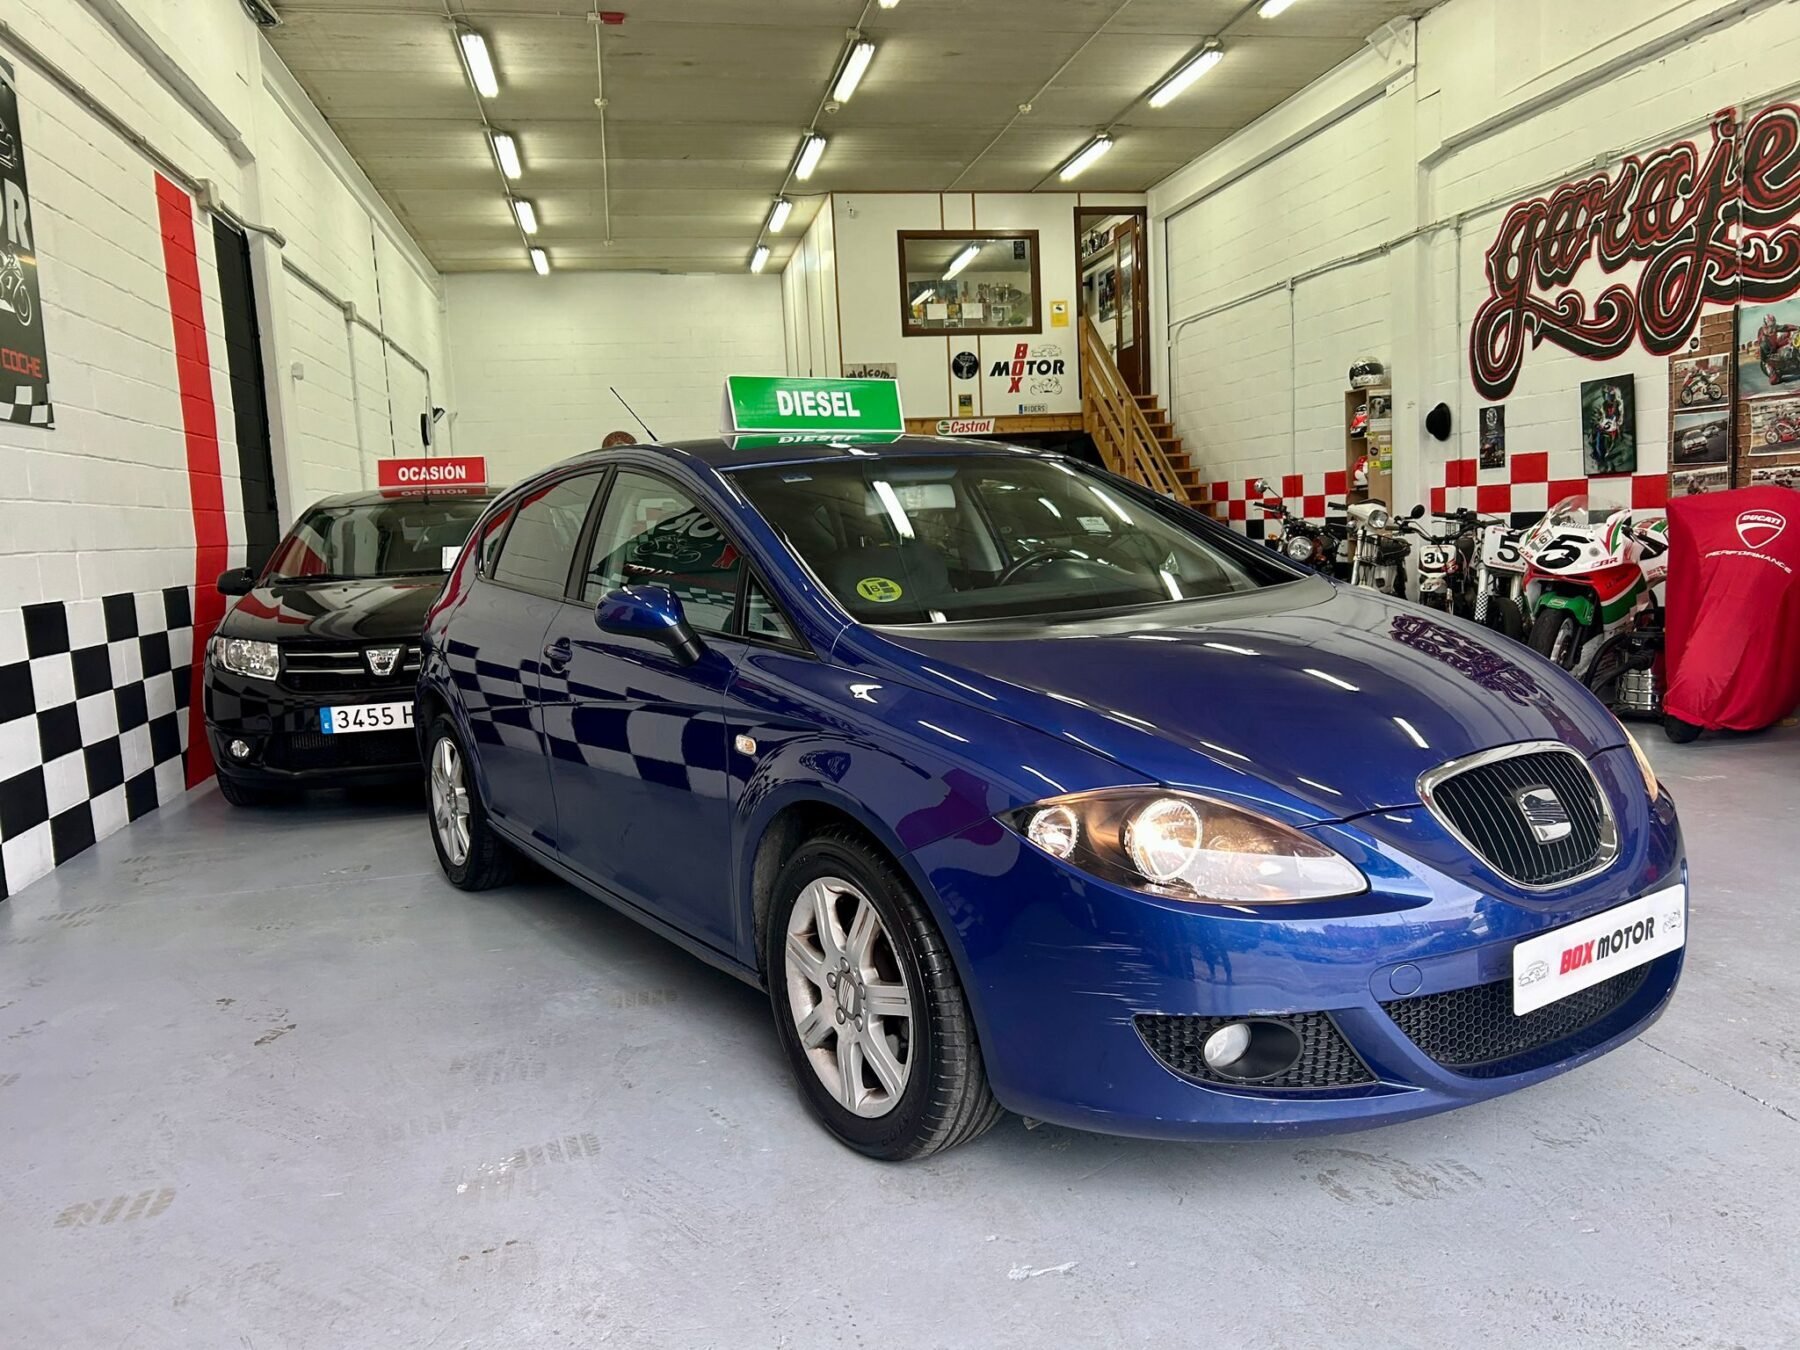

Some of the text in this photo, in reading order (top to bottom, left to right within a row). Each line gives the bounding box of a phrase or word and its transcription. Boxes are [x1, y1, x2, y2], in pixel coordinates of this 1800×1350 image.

[989, 359, 1065, 377] MOTOR
[1008, 343, 1029, 393] BOX
[776, 390, 861, 417] DIESEL
[951, 421, 991, 434] Castrol
[397, 462, 467, 482] OCASIÓN
[1741, 514, 1782, 525] DUCATI
[1497, 534, 1521, 562] 5
[1536, 534, 1595, 569] 5
[1705, 550, 1793, 574] PERFORMANCE
[336, 706, 394, 729] 3455
[1559, 916, 1655, 976] BOX MOTOR
